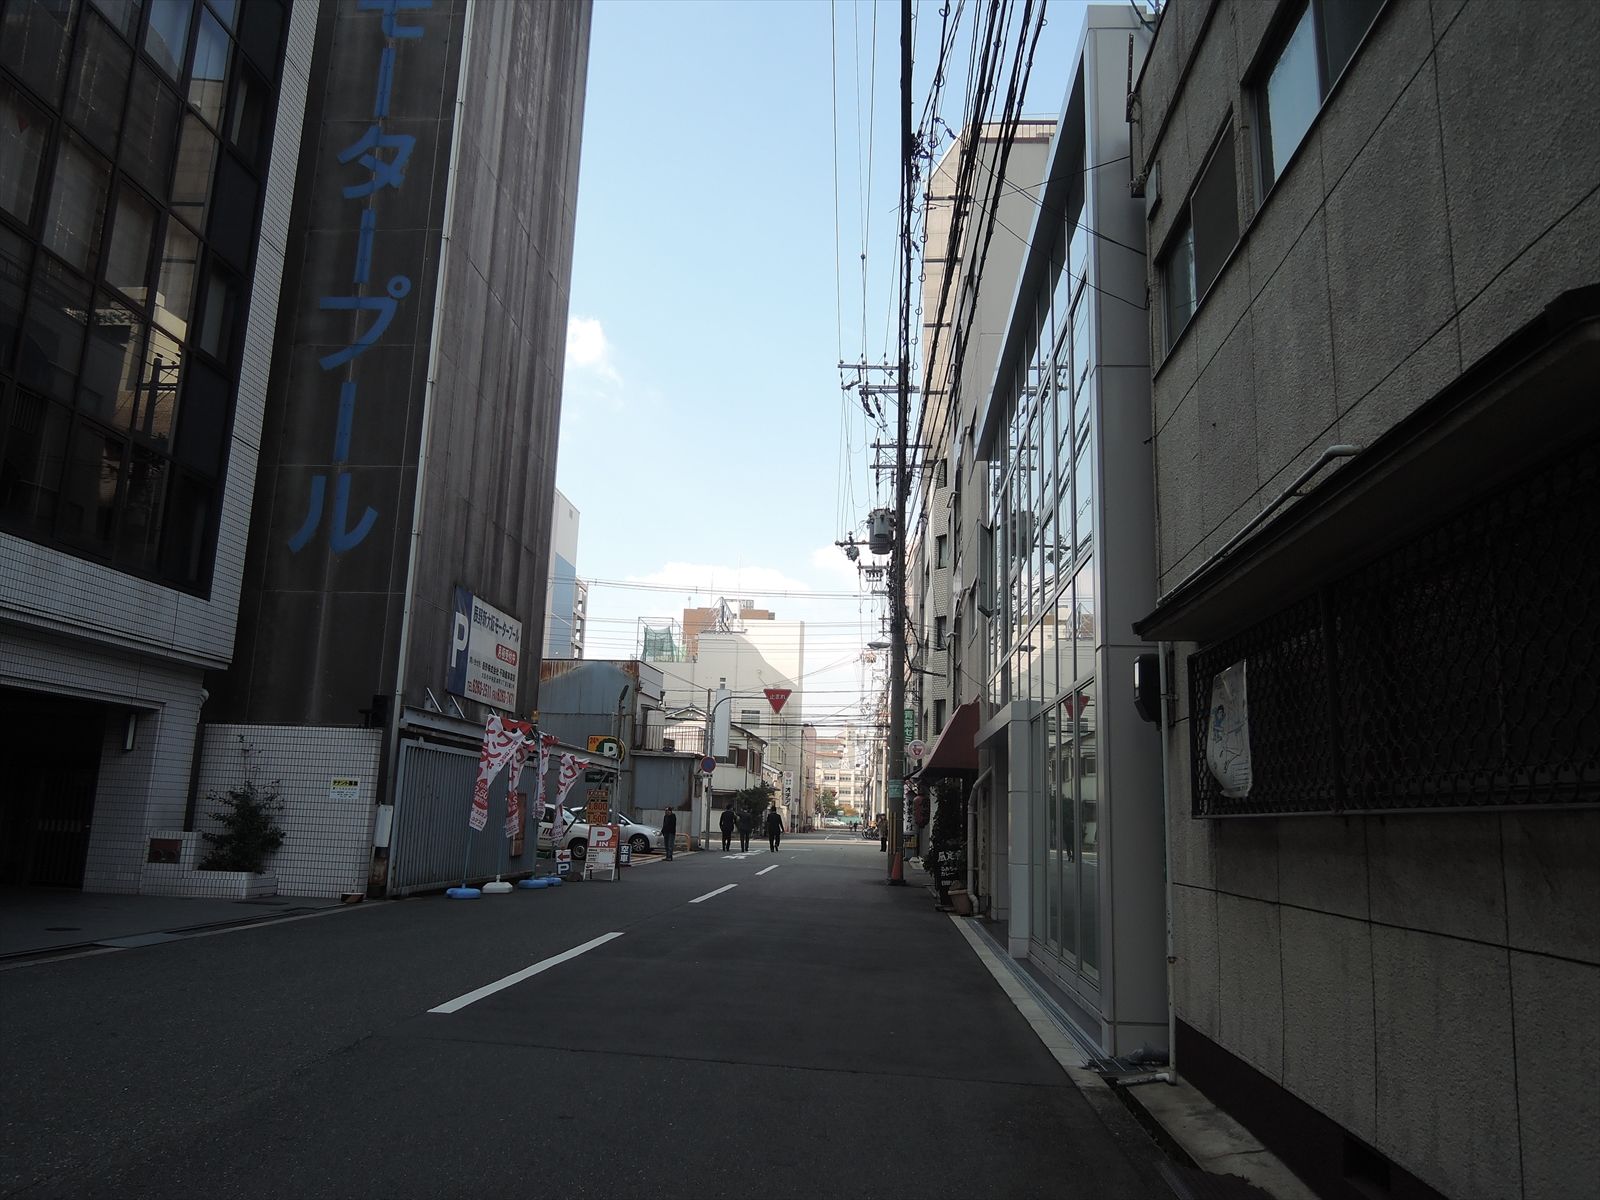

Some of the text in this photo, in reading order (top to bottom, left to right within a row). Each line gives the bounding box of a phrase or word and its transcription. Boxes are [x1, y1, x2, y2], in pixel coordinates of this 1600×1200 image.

[451, 611, 469, 668] P
[604, 742, 617, 758] P
[589, 827, 612, 847] P
[558, 863, 569, 875] P
